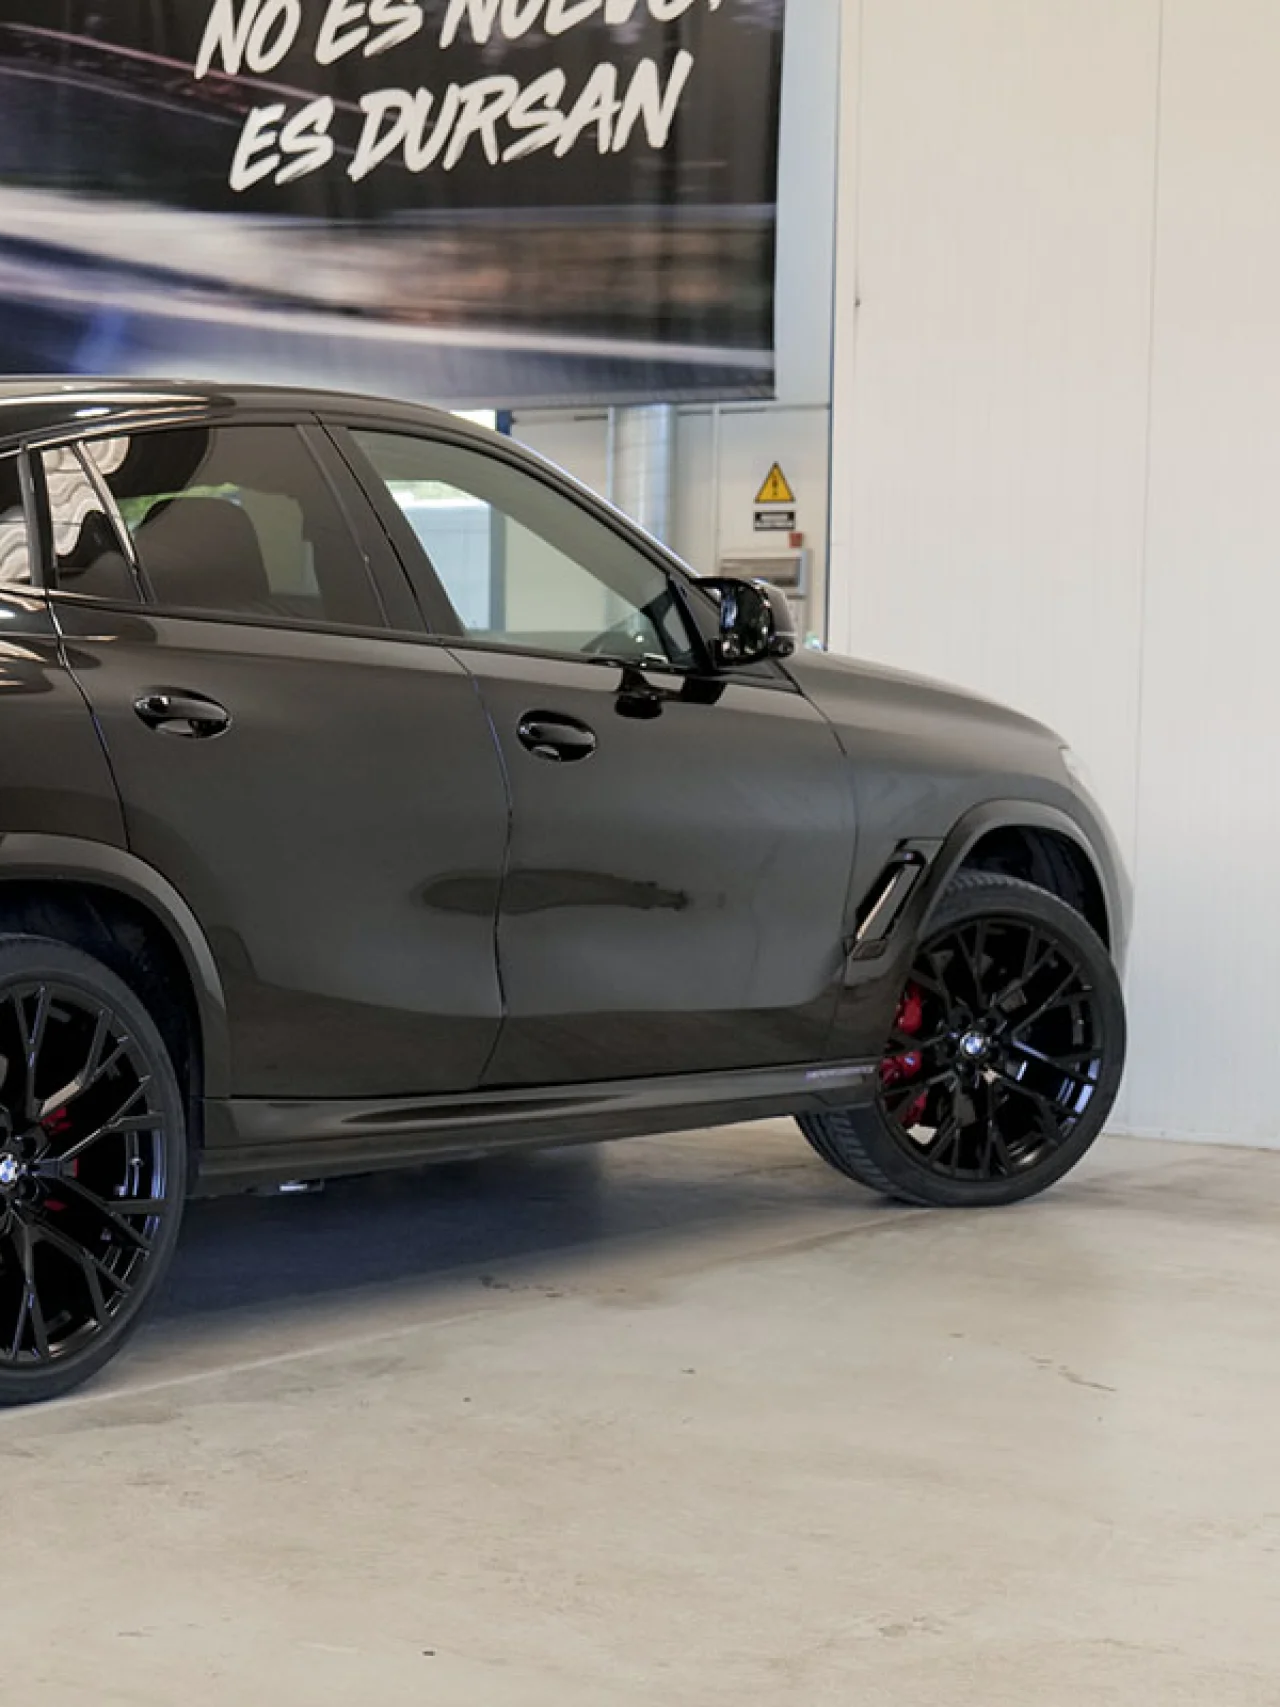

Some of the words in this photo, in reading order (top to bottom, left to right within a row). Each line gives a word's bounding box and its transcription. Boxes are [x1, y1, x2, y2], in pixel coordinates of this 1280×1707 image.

[193, 0, 301, 80] NO
[316, 0, 424, 65] ES
[229, 96, 333, 191] ES
[347, 49, 694, 182] DURSAN
